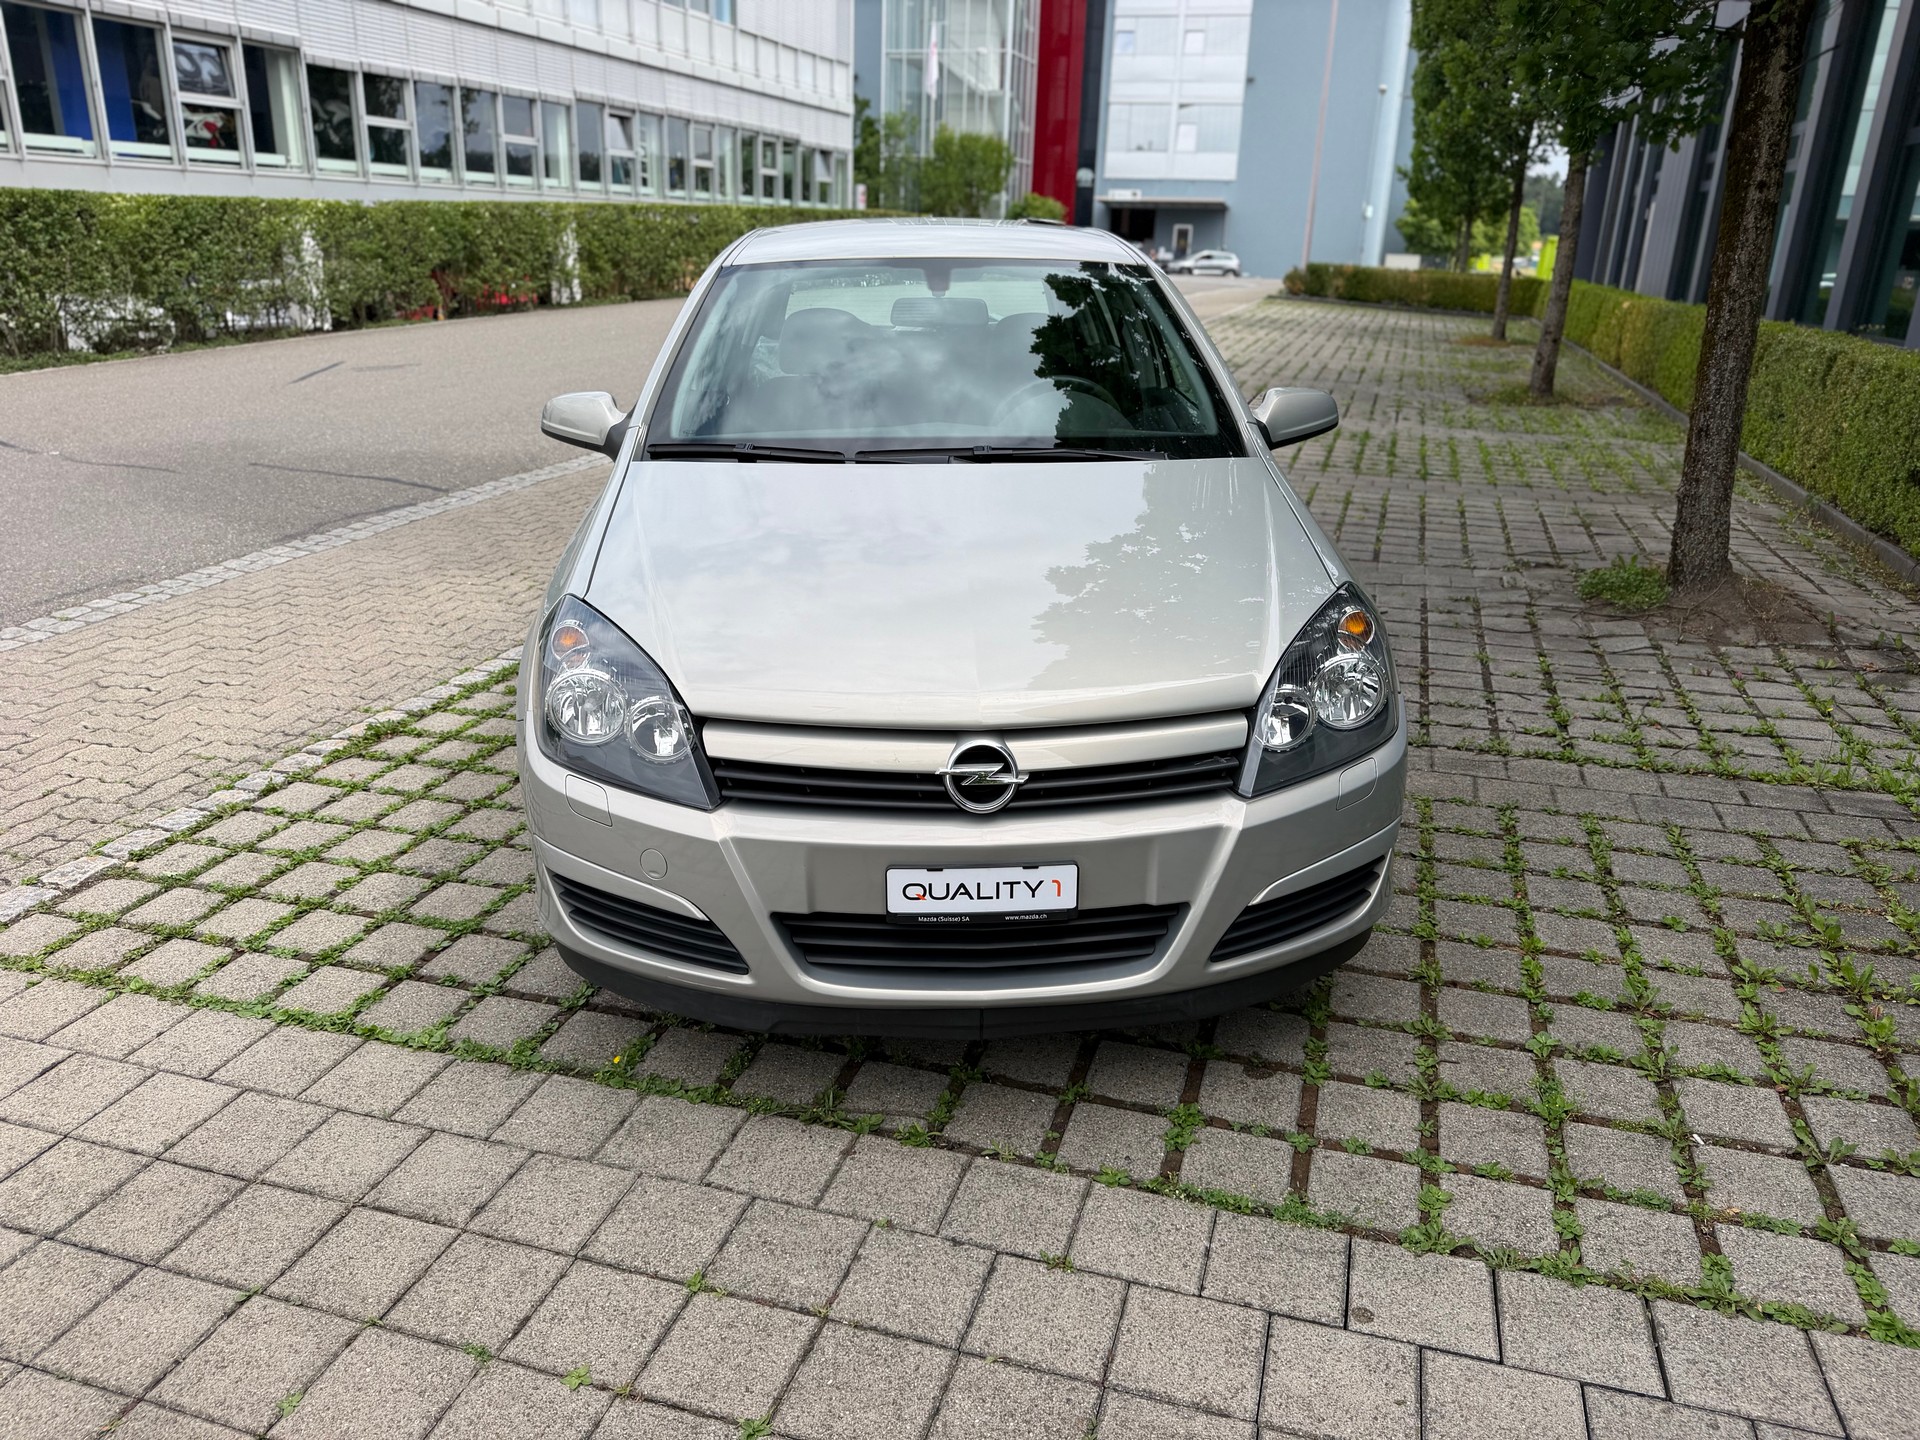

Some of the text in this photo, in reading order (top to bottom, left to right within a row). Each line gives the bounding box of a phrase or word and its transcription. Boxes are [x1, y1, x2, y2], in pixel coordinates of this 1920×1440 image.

[902, 879, 1062, 901] QUALITY 1
[937, 915, 961, 923] (Suisse)
